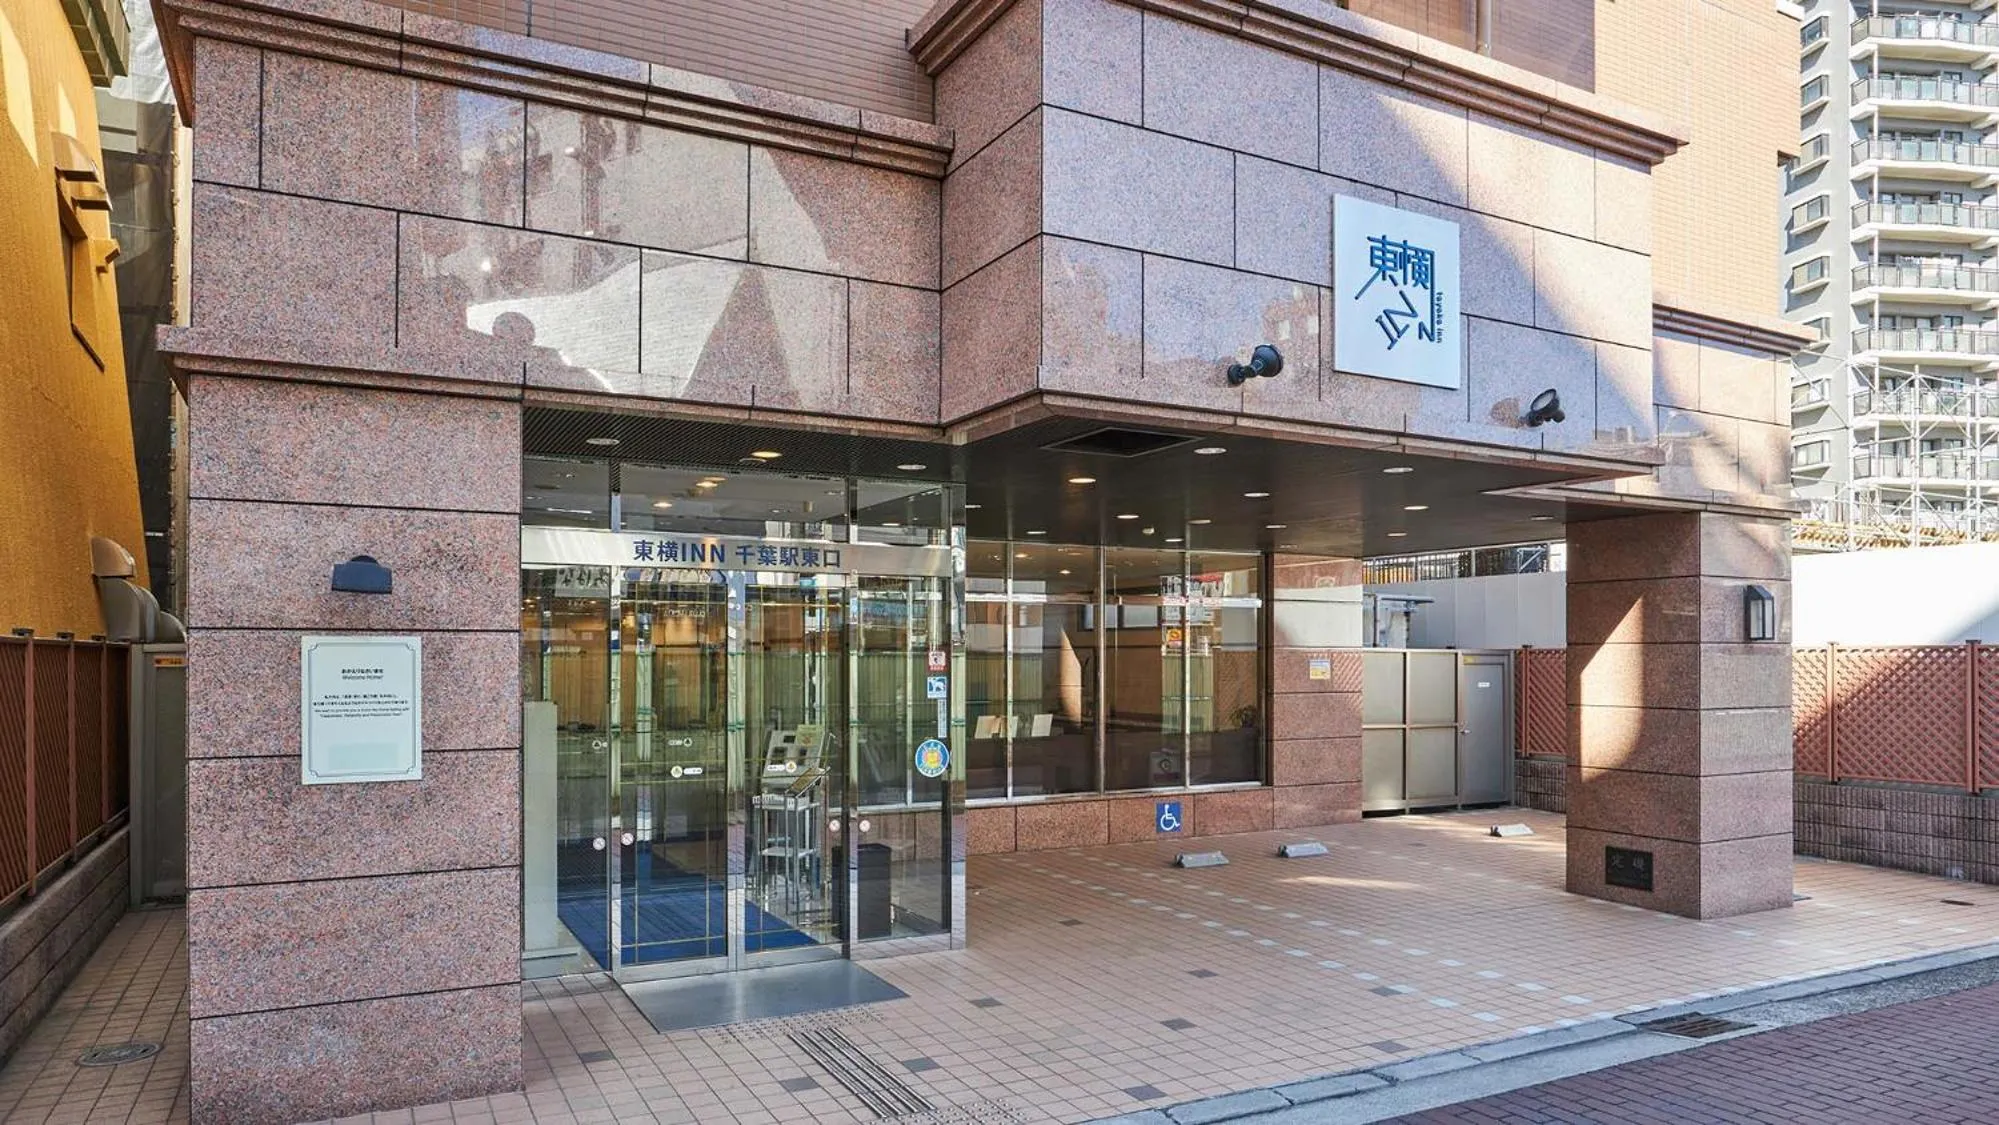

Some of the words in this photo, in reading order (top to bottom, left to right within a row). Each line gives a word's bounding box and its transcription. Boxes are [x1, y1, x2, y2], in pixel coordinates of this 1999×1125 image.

[633, 540, 726, 563] 東横INN
[735, 543, 841, 568] 千葉駅東口
